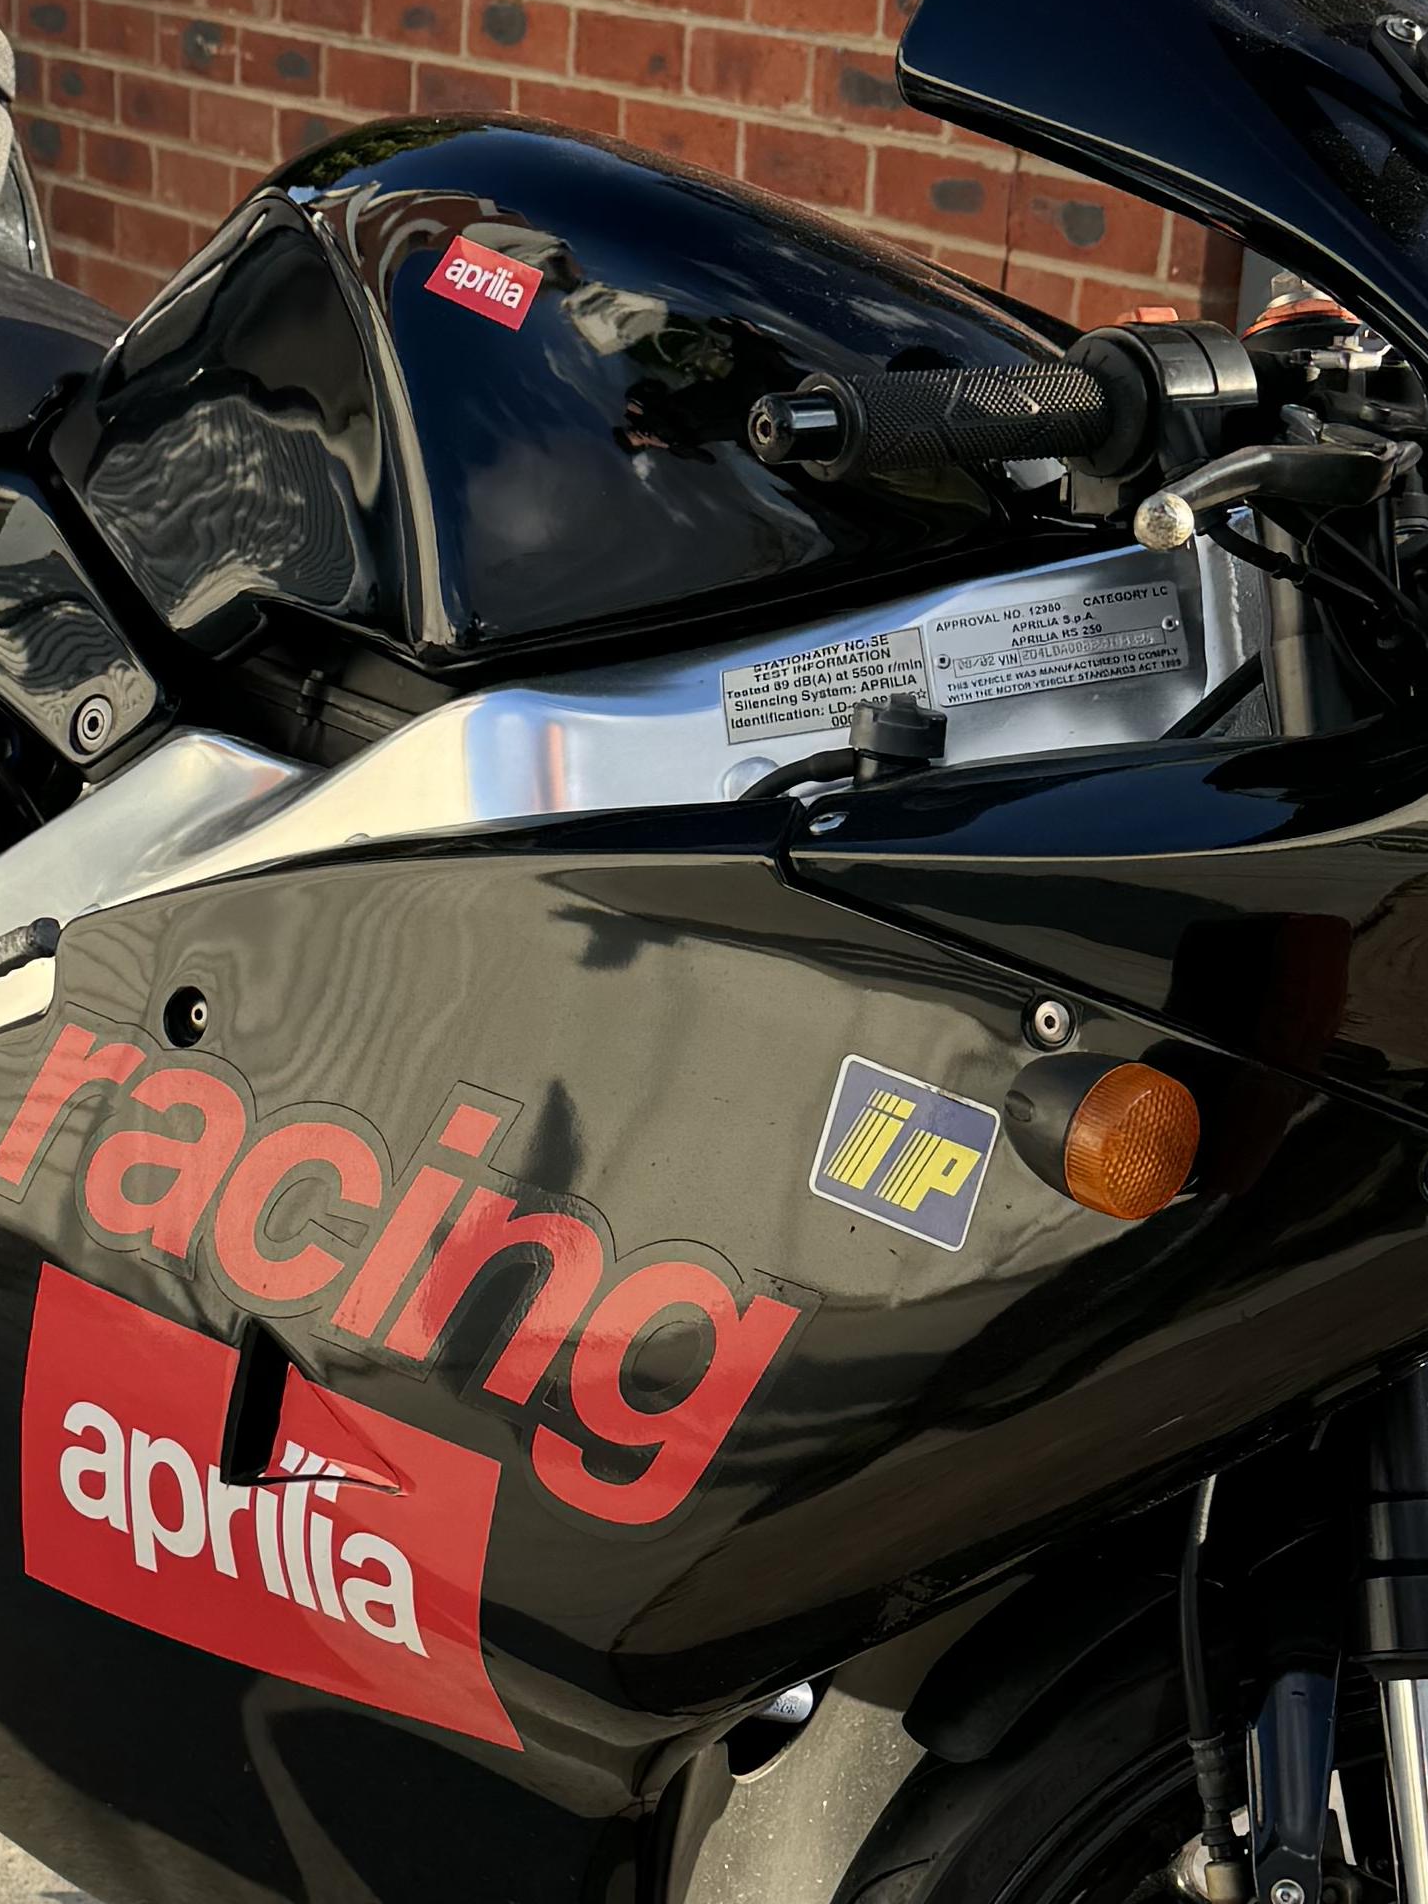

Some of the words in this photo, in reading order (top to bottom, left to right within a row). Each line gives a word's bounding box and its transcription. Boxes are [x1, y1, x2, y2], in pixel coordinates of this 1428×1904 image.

[444, 258, 524, 309] aprilia
[934, 612, 1000, 632] APPROVAL
[1082, 587, 1149, 608] CATEGORY
[1151, 584, 1168, 597] LC
[1010, 616, 1059, 633] APRILIA
[1010, 630, 1058, 647] APRILIA
[1081, 623, 1103, 635] 250
[726, 683, 769, 700] Tested
[792, 671, 832, 689] dB(A)
[835, 669, 849, 681] at
[851, 663, 883, 679] 5500
[886, 656, 923, 673] r/min
[753, 667, 789, 682] TEST
[792, 647, 891, 675] INFORMATION
[946, 680, 969, 692] THIS
[970, 673, 1013, 688] VEHICLE
[1015, 668, 1037, 680] WAS
[1038, 654, 1121, 676] MANUFACTURED
[1122, 652, 1136, 662] TO
[1137, 646, 1179, 661] COMPLY
[998, 652, 1018, 666] VIN
[733, 691, 798, 712] Silencing
[800, 683, 857, 703] System:
[859, 673, 917, 693] APRILIA
[946, 690, 973, 703] WITH
[975, 687, 993, 698] THE
[995, 681, 1031, 695] MOTOR
[1033, 673, 1075, 689] VEHICLE
[1077, 663, 1136, 682] STANDARDS
[1137, 660, 1157, 672] ACT
[730, 704, 825, 729] Identification:
[59, 1399, 430, 1659] aprilia
